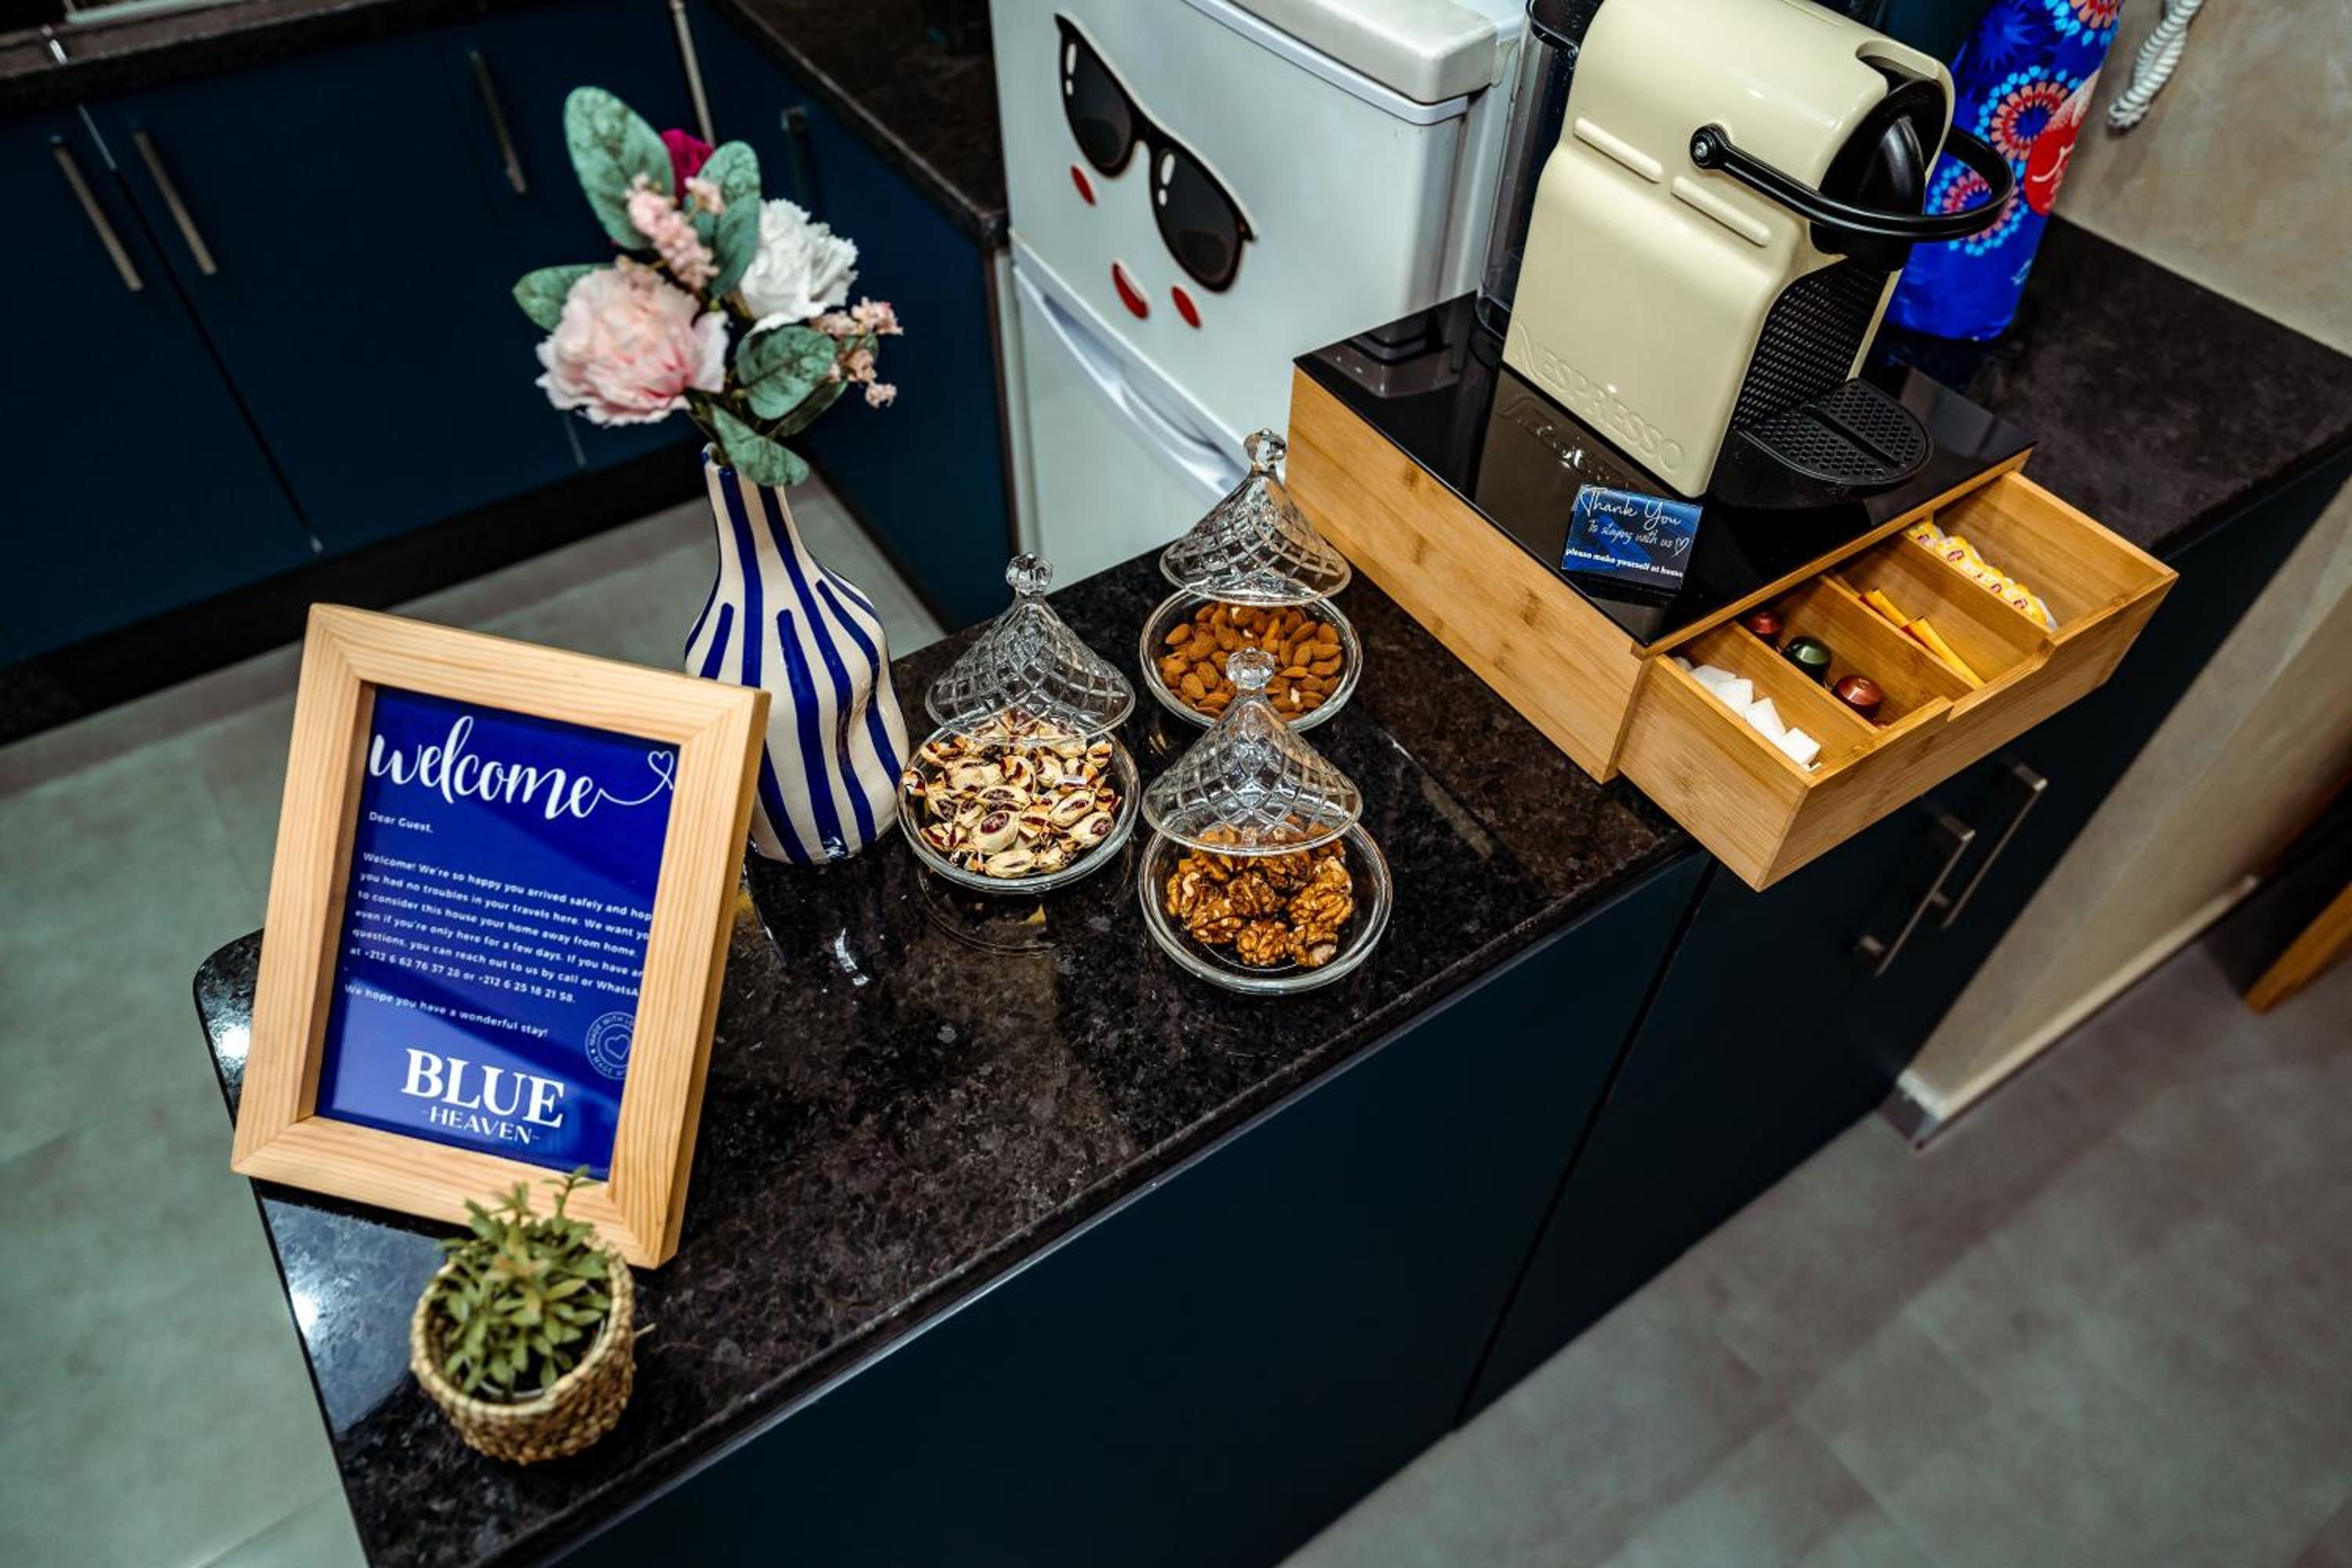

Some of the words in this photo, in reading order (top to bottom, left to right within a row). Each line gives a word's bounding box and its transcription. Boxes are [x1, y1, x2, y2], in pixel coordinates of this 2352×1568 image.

[1581, 487, 1637, 517] Thank
[1643, 500, 1681, 531] You
[1565, 547, 1592, 559] please
[1593, 554, 1616, 564] make
[1616, 558, 1650, 571] yourself
[1661, 566, 1683, 578] home
[1661, 539, 1672, 548] us
[369, 715, 601, 820] welcome
[369, 811, 396, 824] Dear
[361, 873, 380, 883] you
[383, 875, 404, 887] had
[406, 882, 420, 891] no
[423, 885, 469, 902] troubles
[471, 895, 482, 905] in
[485, 899, 510, 910] your
[512, 904, 550, 920] travels
[584, 919, 602, 930] We
[604, 924, 633, 937] want
[636, 931, 648, 940] yo
[419, 863, 450, 878] We're
[452, 873, 465, 881] so
[467, 873, 502, 891] happy
[503, 884, 524, 894] you
[527, 888, 567, 903] arrived
[569, 897, 603, 912] safely
[605, 905, 627, 916] and
[630, 908, 651, 920] hop
[355, 910, 380, 921] even
[383, 914, 392, 924] if
[394, 919, 427, 931] you're
[430, 926, 454, 938] only
[456, 930, 481, 943] here
[484, 936, 500, 947] for
[513, 942, 533, 954] few
[567, 954, 577, 964] If
[578, 958, 599, 968] you
[602, 961, 629, 975] have
[358, 891, 370, 899] to
[372, 895, 419, 909] consider
[421, 904, 442, 915] this
[445, 908, 477, 923] house
[480, 917, 505, 928] your
[508, 922, 539, 936] home
[542, 931, 571, 945] away
[573, 935, 601, 949] from
[350, 947, 361, 956] at
[399, 956, 412, 967] 62
[416, 960, 428, 971] 76
[503, 980, 511, 989] 6
[514, 982, 527, 993] 25
[544, 989, 557, 999] 21
[409, 942, 430, 952] you
[433, 946, 452, 956] can
[456, 951, 486, 964] reach
[488, 959, 507, 969] out
[511, 962, 523, 971] to
[525, 966, 539, 975] us
[541, 967, 555, 980] by
[557, 974, 579, 983] call
[581, 978, 593, 987] or
[596, 980, 637, 996] WhatsA
[345, 984, 362, 995] We
[365, 989, 393, 1002] hope
[396, 998, 416, 1007] you
[420, 1000, 446, 1014] have
[459, 1011, 517, 1030] wonderful
[521, 1025, 548, 1038] stay!
[401, 1047, 565, 1129] BLUE
